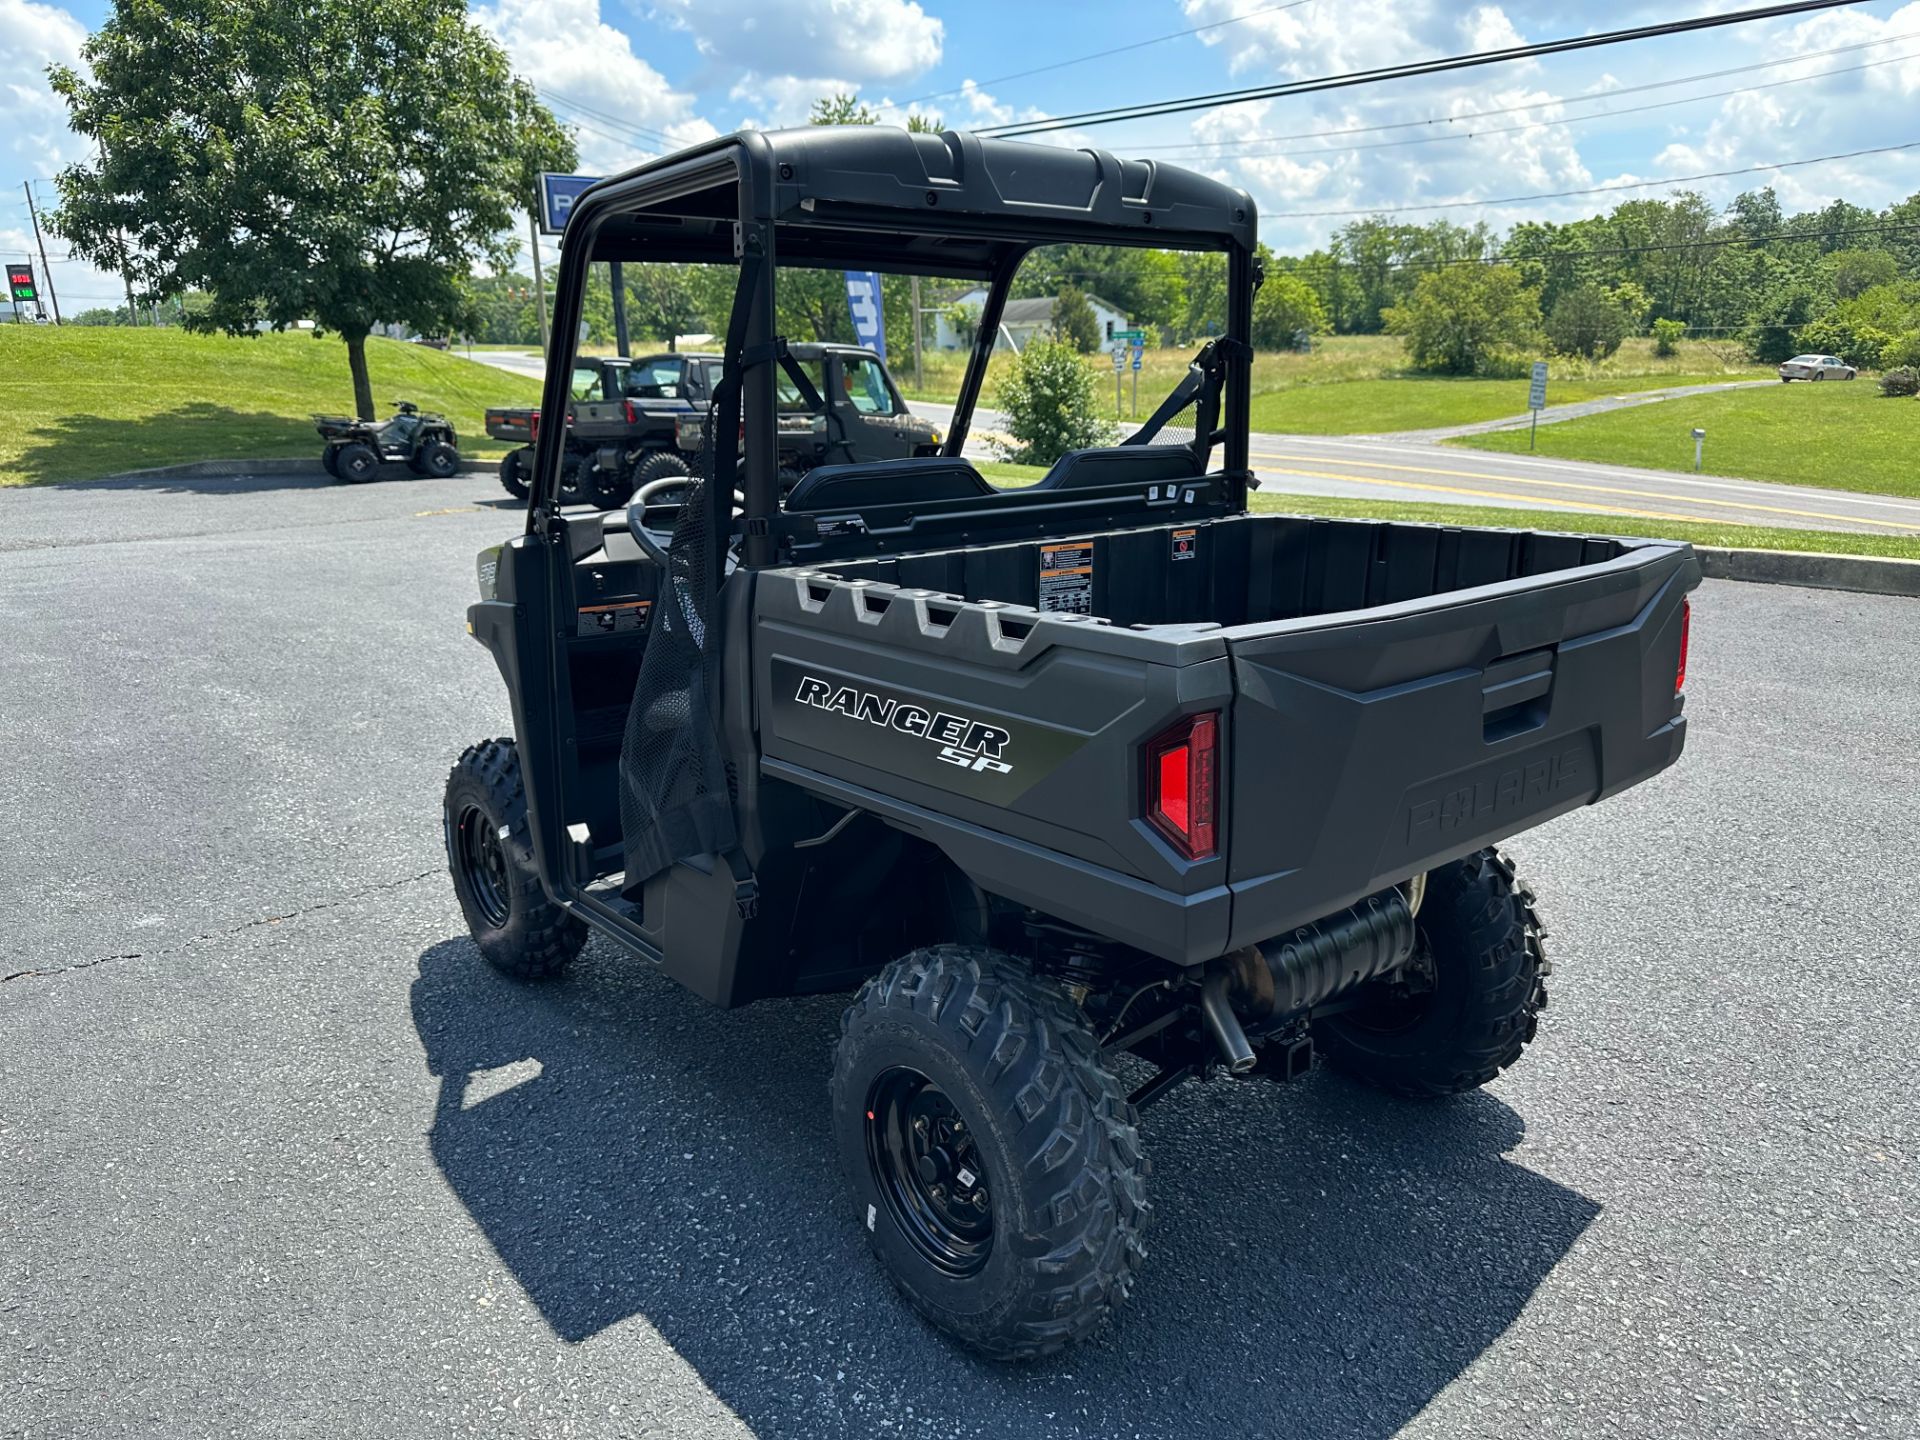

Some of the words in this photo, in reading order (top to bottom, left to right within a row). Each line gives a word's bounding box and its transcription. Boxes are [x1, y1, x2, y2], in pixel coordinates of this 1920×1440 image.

[795, 676, 1010, 759] RANGER
[937, 747, 1014, 774] SP
[1406, 747, 1585, 846] POLARIS
